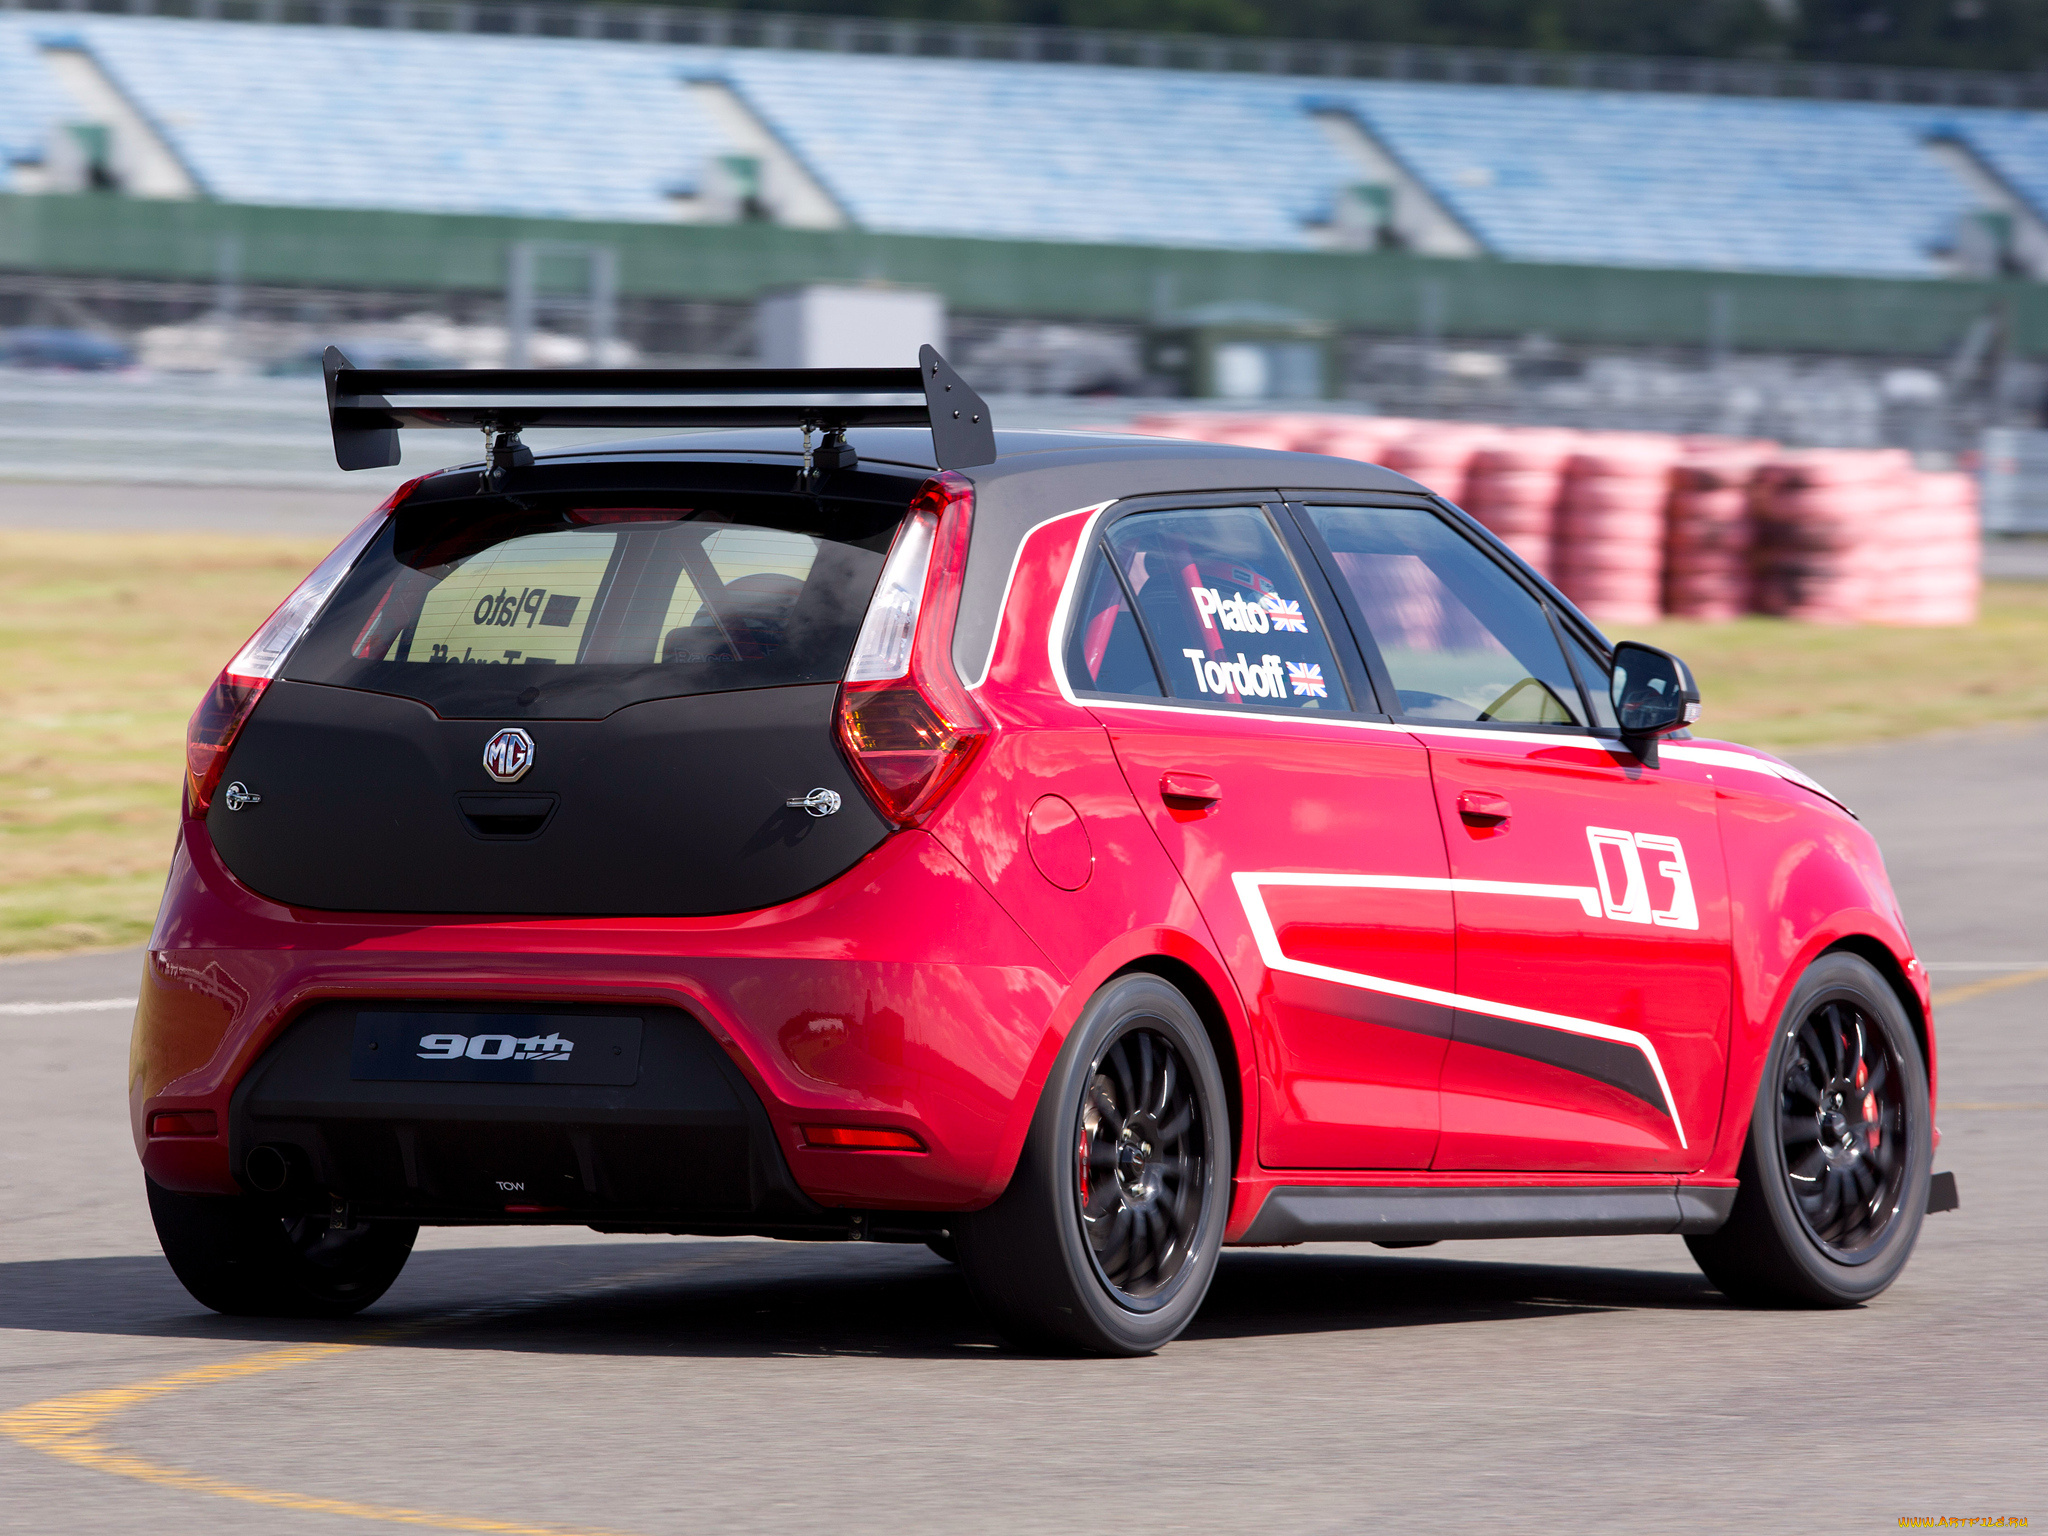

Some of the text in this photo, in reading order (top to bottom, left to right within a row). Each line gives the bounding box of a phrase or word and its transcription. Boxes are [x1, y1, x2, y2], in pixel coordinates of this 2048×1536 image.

[1191, 586, 1270, 634] Plato
[1182, 648, 1288, 699] Tordoff
[486, 731, 529, 776] MG
[416, 1032, 574, 1061] 90th
[495, 1181, 525, 1191] TOW
